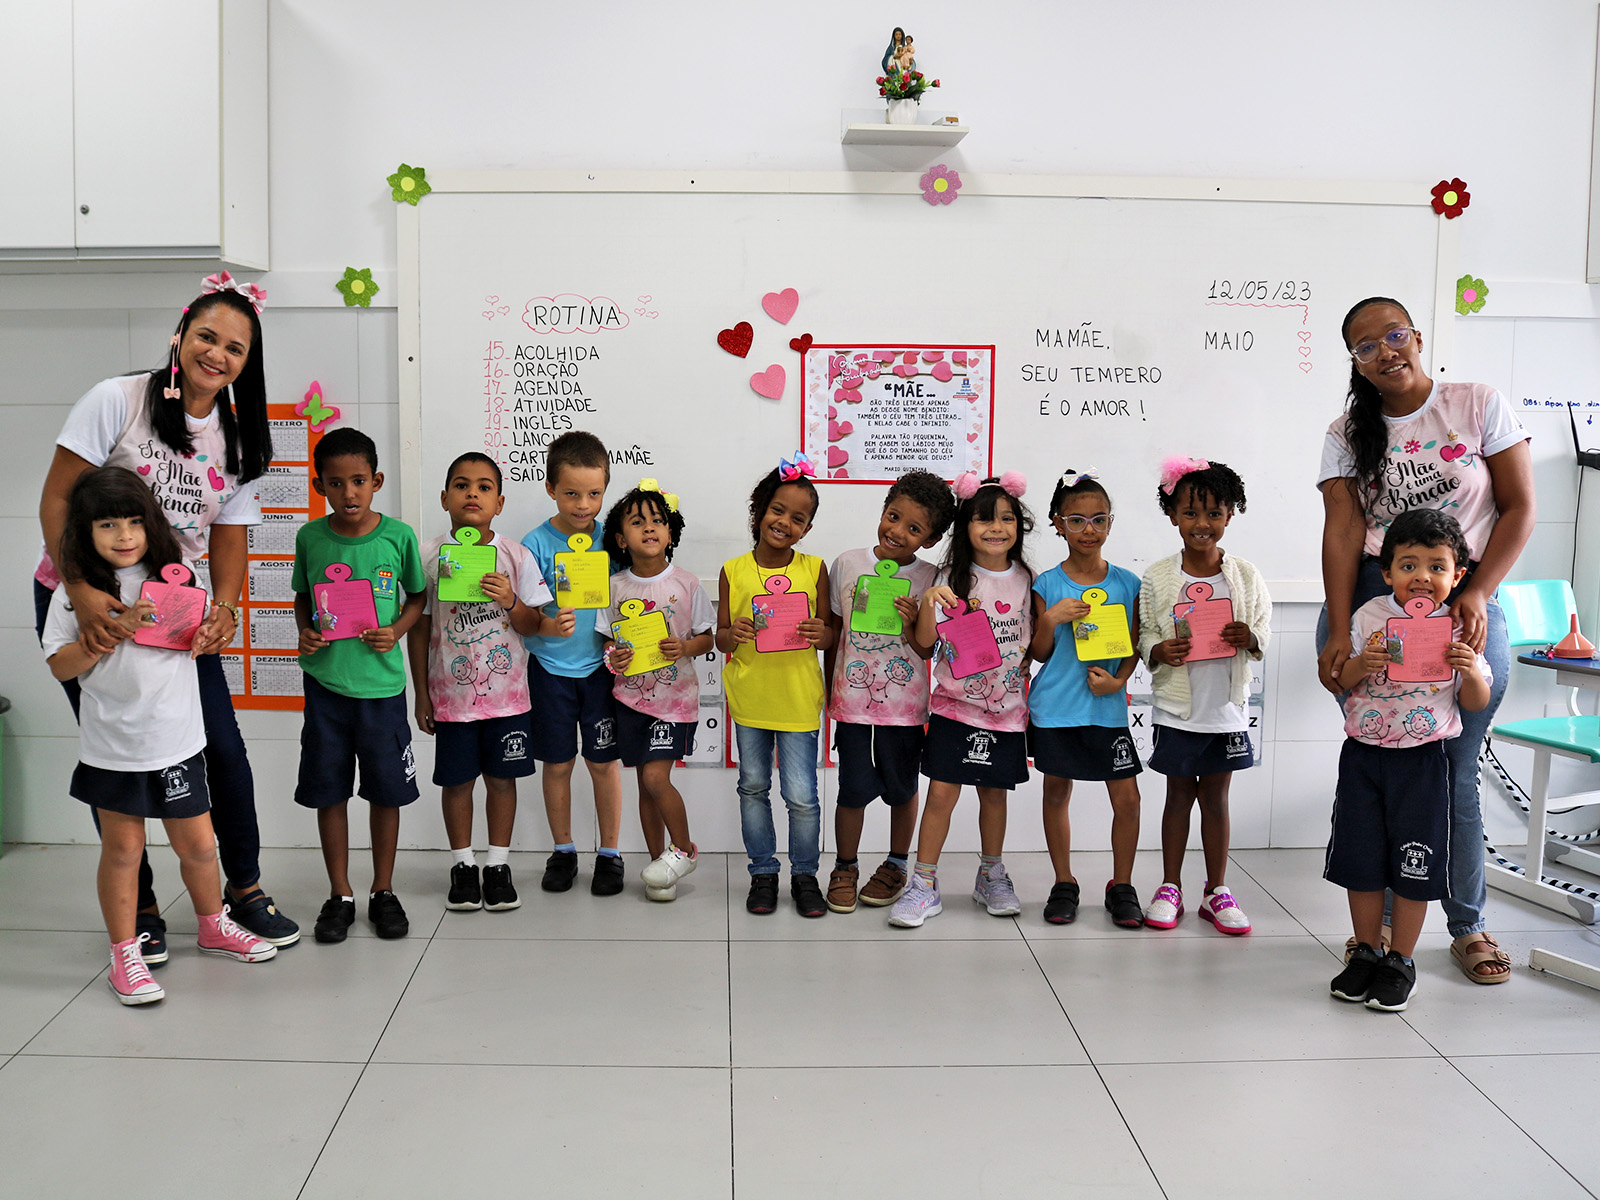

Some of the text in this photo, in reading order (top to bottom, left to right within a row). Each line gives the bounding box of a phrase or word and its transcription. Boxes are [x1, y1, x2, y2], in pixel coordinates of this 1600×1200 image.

[1208, 280, 1311, 300] 12/05/23
[534, 306, 620, 325] ROTINA
[1204, 331, 1254, 351] MAIO
[514, 345, 600, 360] ACOLHIDA
[513, 361, 578, 379] ORAÇÃO
[1021, 365, 1162, 383] SEU TEMPERO
[513, 381, 583, 396] AGENDA
[513, 398, 597, 413] ATIVIDADE
[1039, 393, 1050, 416] É
[1060, 400, 1070, 416] O
[1081, 400, 1130, 416] AMOR
[513, 411, 573, 429] INGLÊS
[138, 440, 168, 461] Ser
[509, 450, 548, 464] CART
[156, 460, 202, 486] Mãe
[510, 465, 545, 482] SAÍD
[1386, 459, 1437, 487] Mãe
[1414, 470, 1442, 487] uma
[177, 487, 202, 498] uma
[1380, 477, 1461, 515] Bênção
